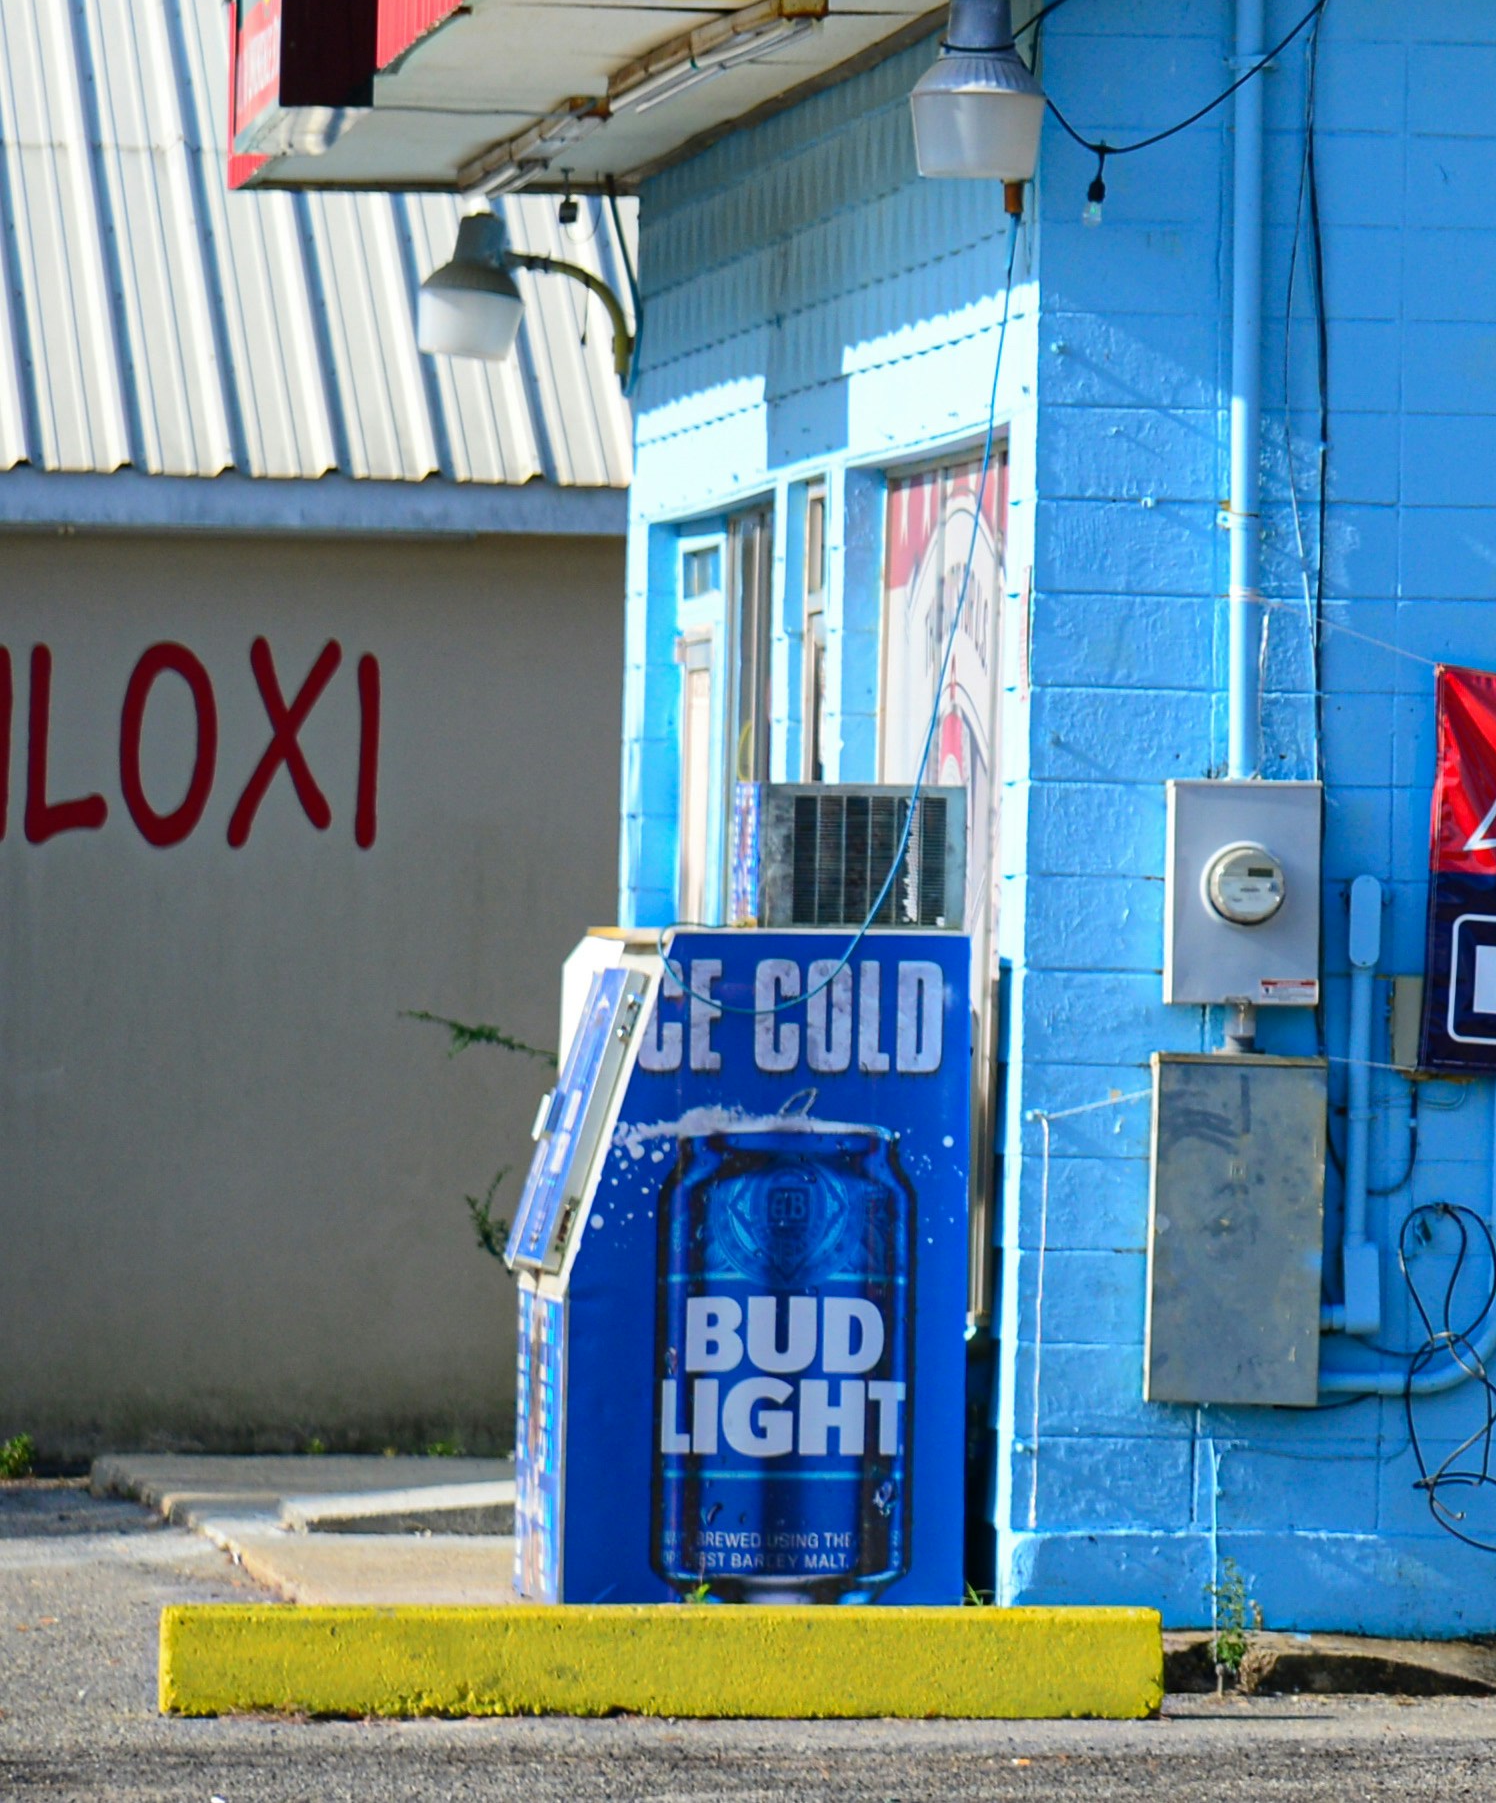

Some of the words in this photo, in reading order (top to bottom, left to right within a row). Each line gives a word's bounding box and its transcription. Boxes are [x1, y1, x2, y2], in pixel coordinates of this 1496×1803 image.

[754, 958, 943, 1073] COLD
[685, 1296, 885, 1373] BUD
[661, 1376, 906, 1457] LIGHT
